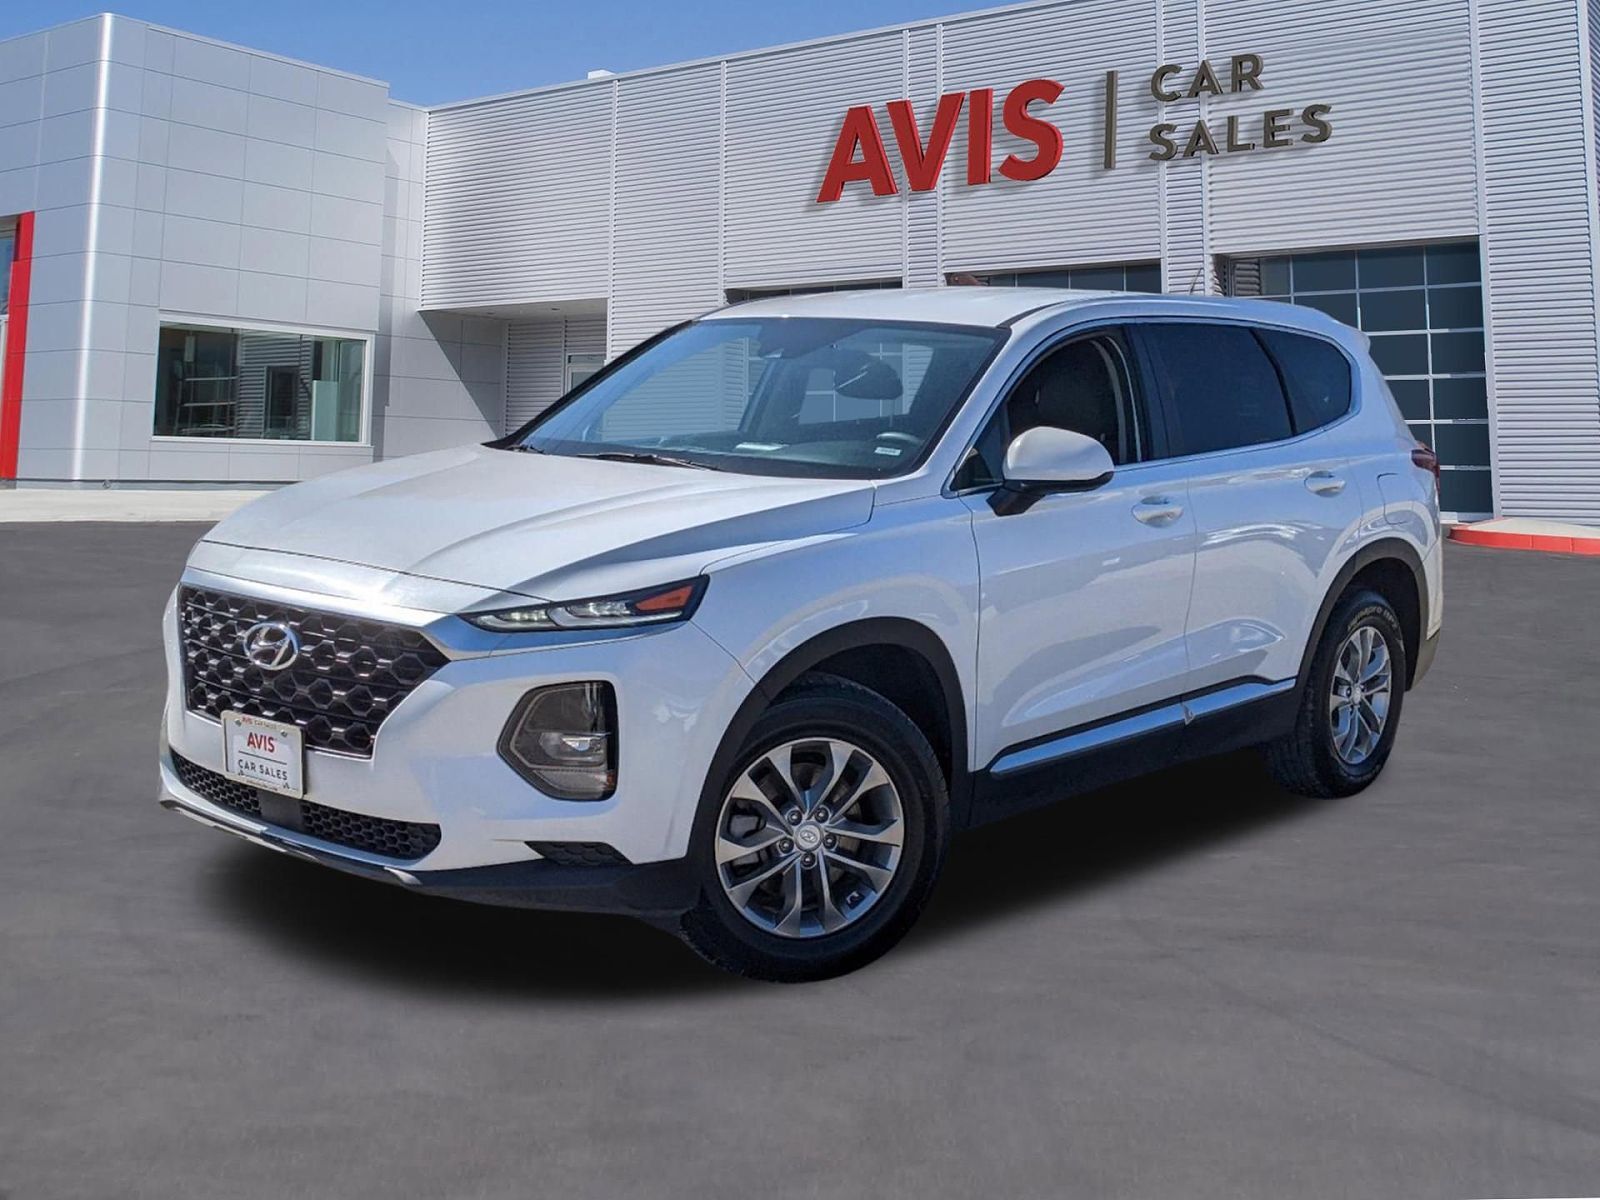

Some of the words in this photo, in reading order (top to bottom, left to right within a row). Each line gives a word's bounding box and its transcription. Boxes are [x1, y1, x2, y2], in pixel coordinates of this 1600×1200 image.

[1150, 53, 1264, 102] CAR
[816, 78, 1065, 203] AVIS
[1149, 103, 1333, 161] SALES
[247, 731, 275, 753] AVIS
[238, 759, 256, 772] CAR
[260, 764, 288, 781] SALES
